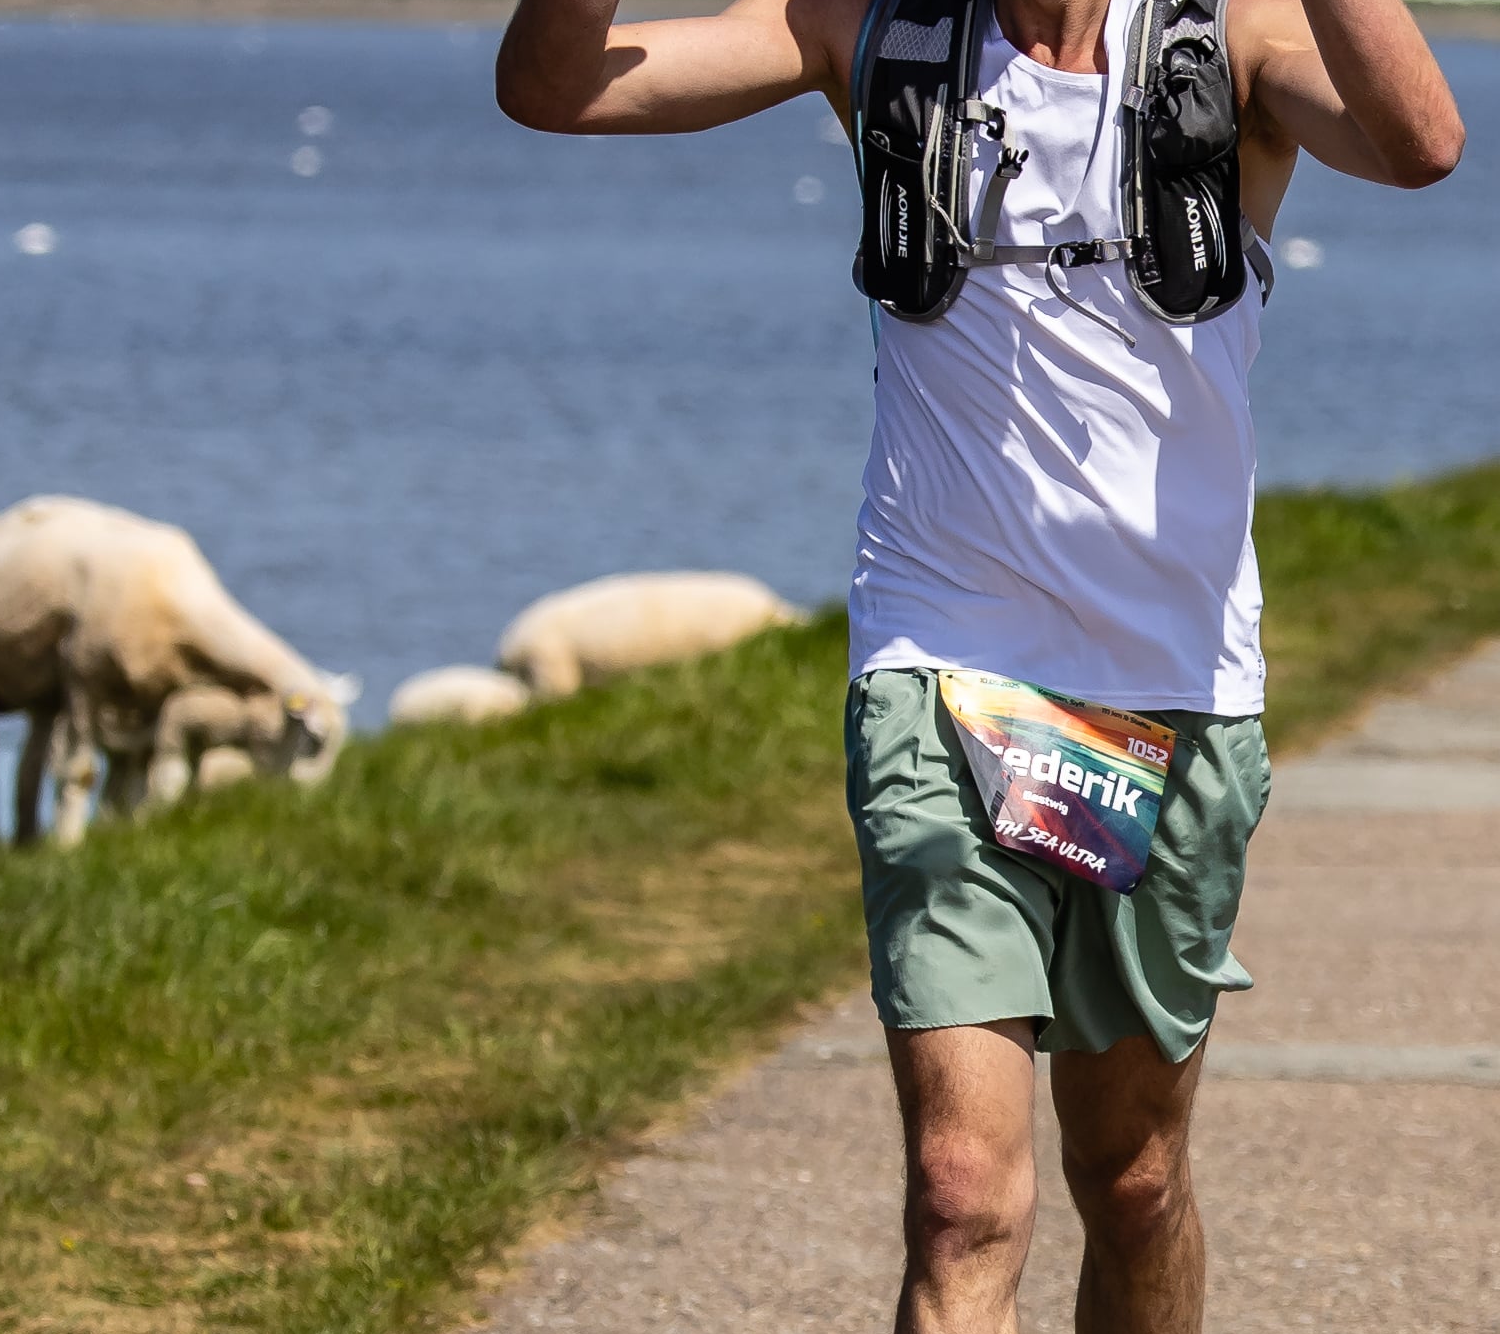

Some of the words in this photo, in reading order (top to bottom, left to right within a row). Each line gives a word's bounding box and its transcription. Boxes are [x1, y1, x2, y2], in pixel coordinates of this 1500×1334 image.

[896, 183, 908, 258] AONIJIE
[1183, 196, 1207, 272] AONIJIE
[975, 734, 1142, 817] ederik
[1127, 737, 1169, 767] 1052
[1020, 826, 1060, 852] SEA
[1058, 841, 1107, 874] ULTRA
